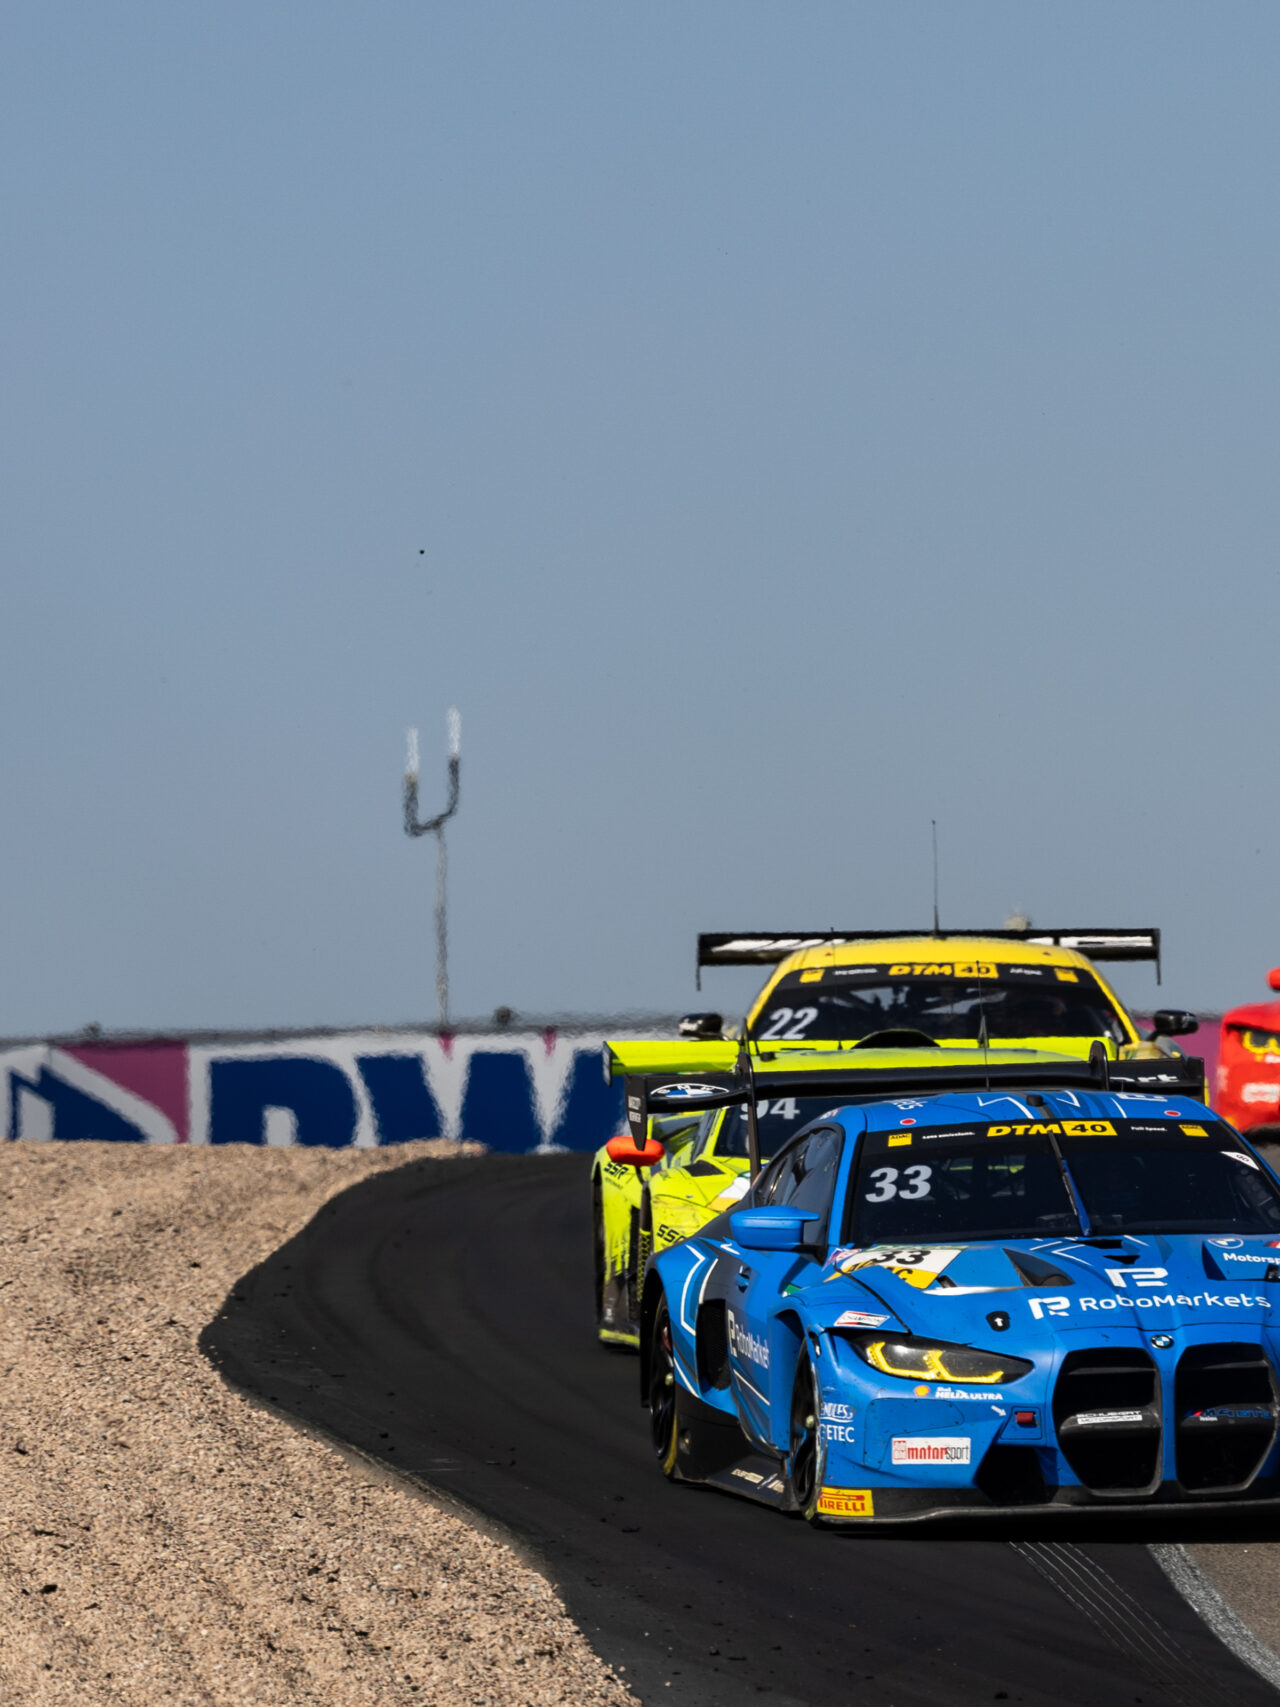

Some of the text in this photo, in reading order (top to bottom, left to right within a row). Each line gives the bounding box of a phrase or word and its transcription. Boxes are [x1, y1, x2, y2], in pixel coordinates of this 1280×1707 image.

[888, 964, 952, 976] DTM
[961, 964, 991, 977] 40
[759, 1006, 819, 1040] 22
[986, 1123, 1109, 1137] DTM 40
[865, 1165, 932, 1203] 33
[1078, 1292, 1272, 1312] RoboMarkets
[935, 1389, 1004, 1400] HELIX ULTRA
[907, 1445, 969, 1462] motorsport
[819, 1492, 866, 1512] PIRELLI
